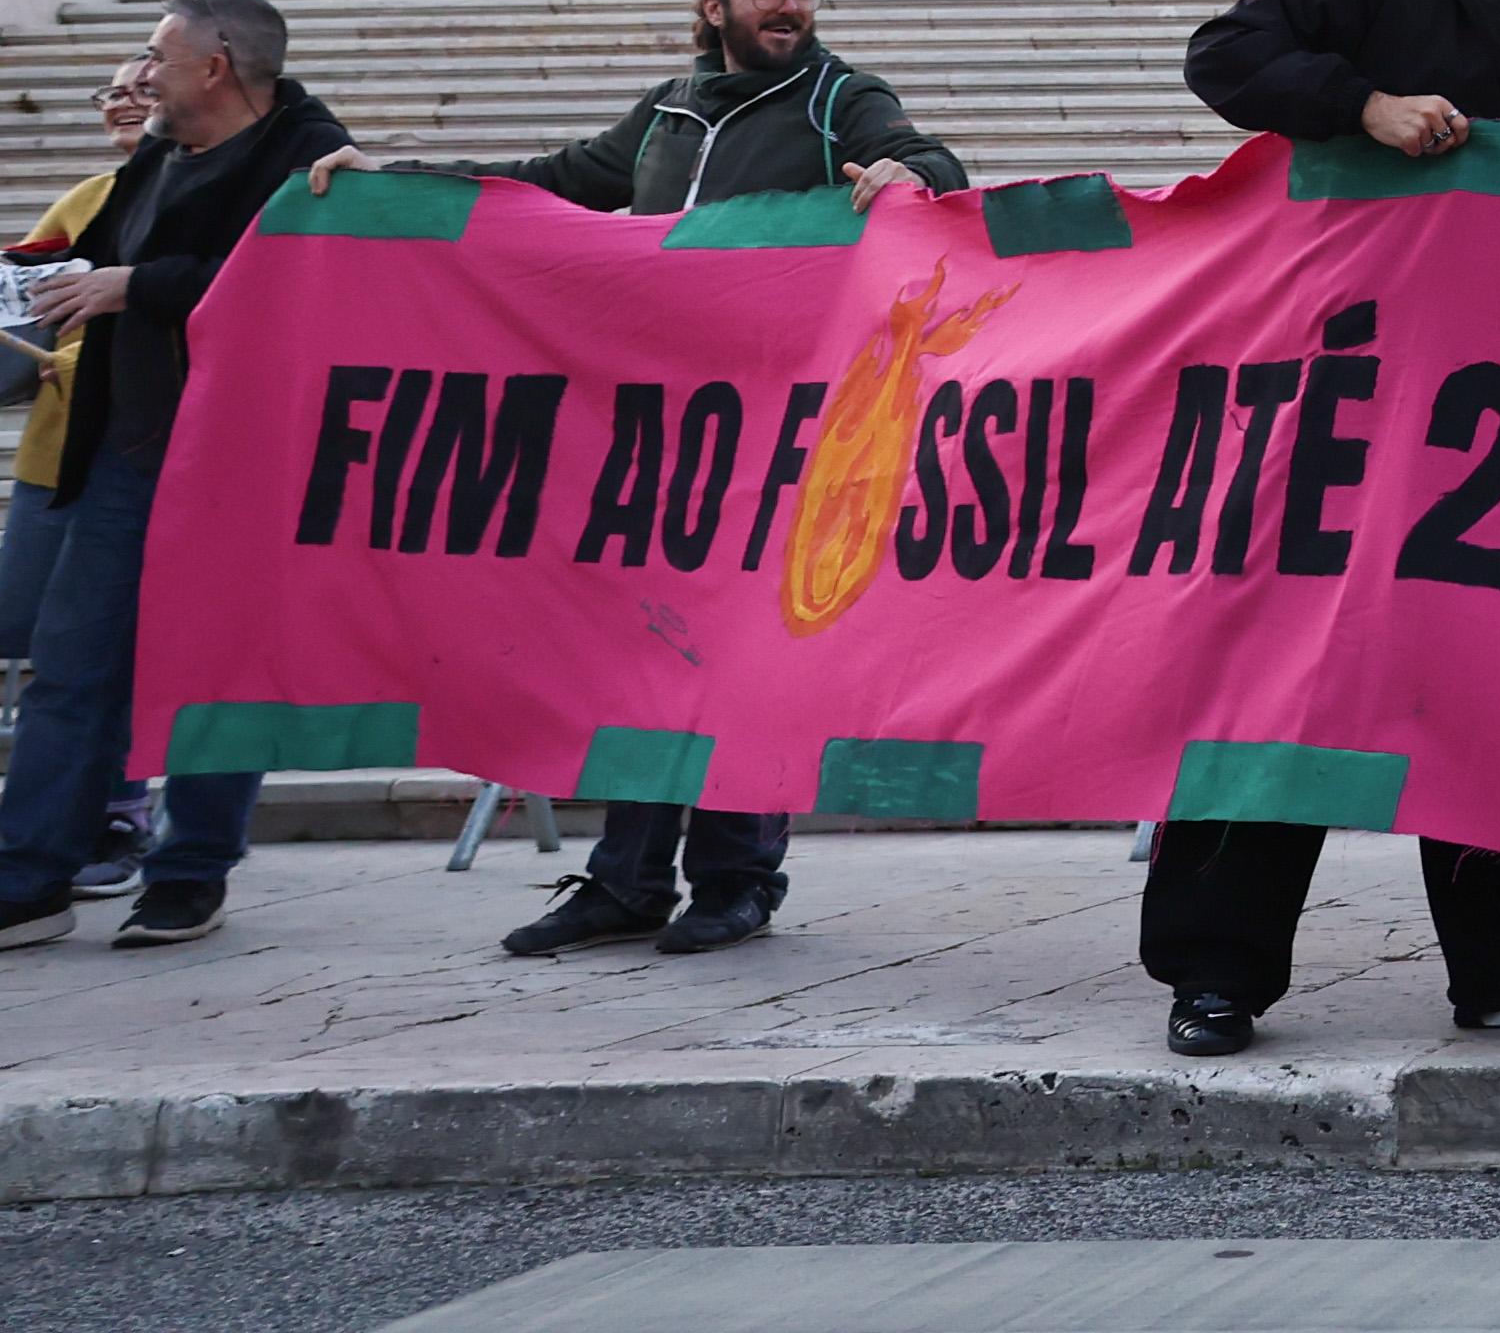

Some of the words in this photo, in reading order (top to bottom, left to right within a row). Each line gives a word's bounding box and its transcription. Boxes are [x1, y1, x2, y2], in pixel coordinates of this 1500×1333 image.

[295, 365, 569, 559] FIM
[574, 381, 743, 572] AO
[1127, 299, 1382, 577] ATÉ
